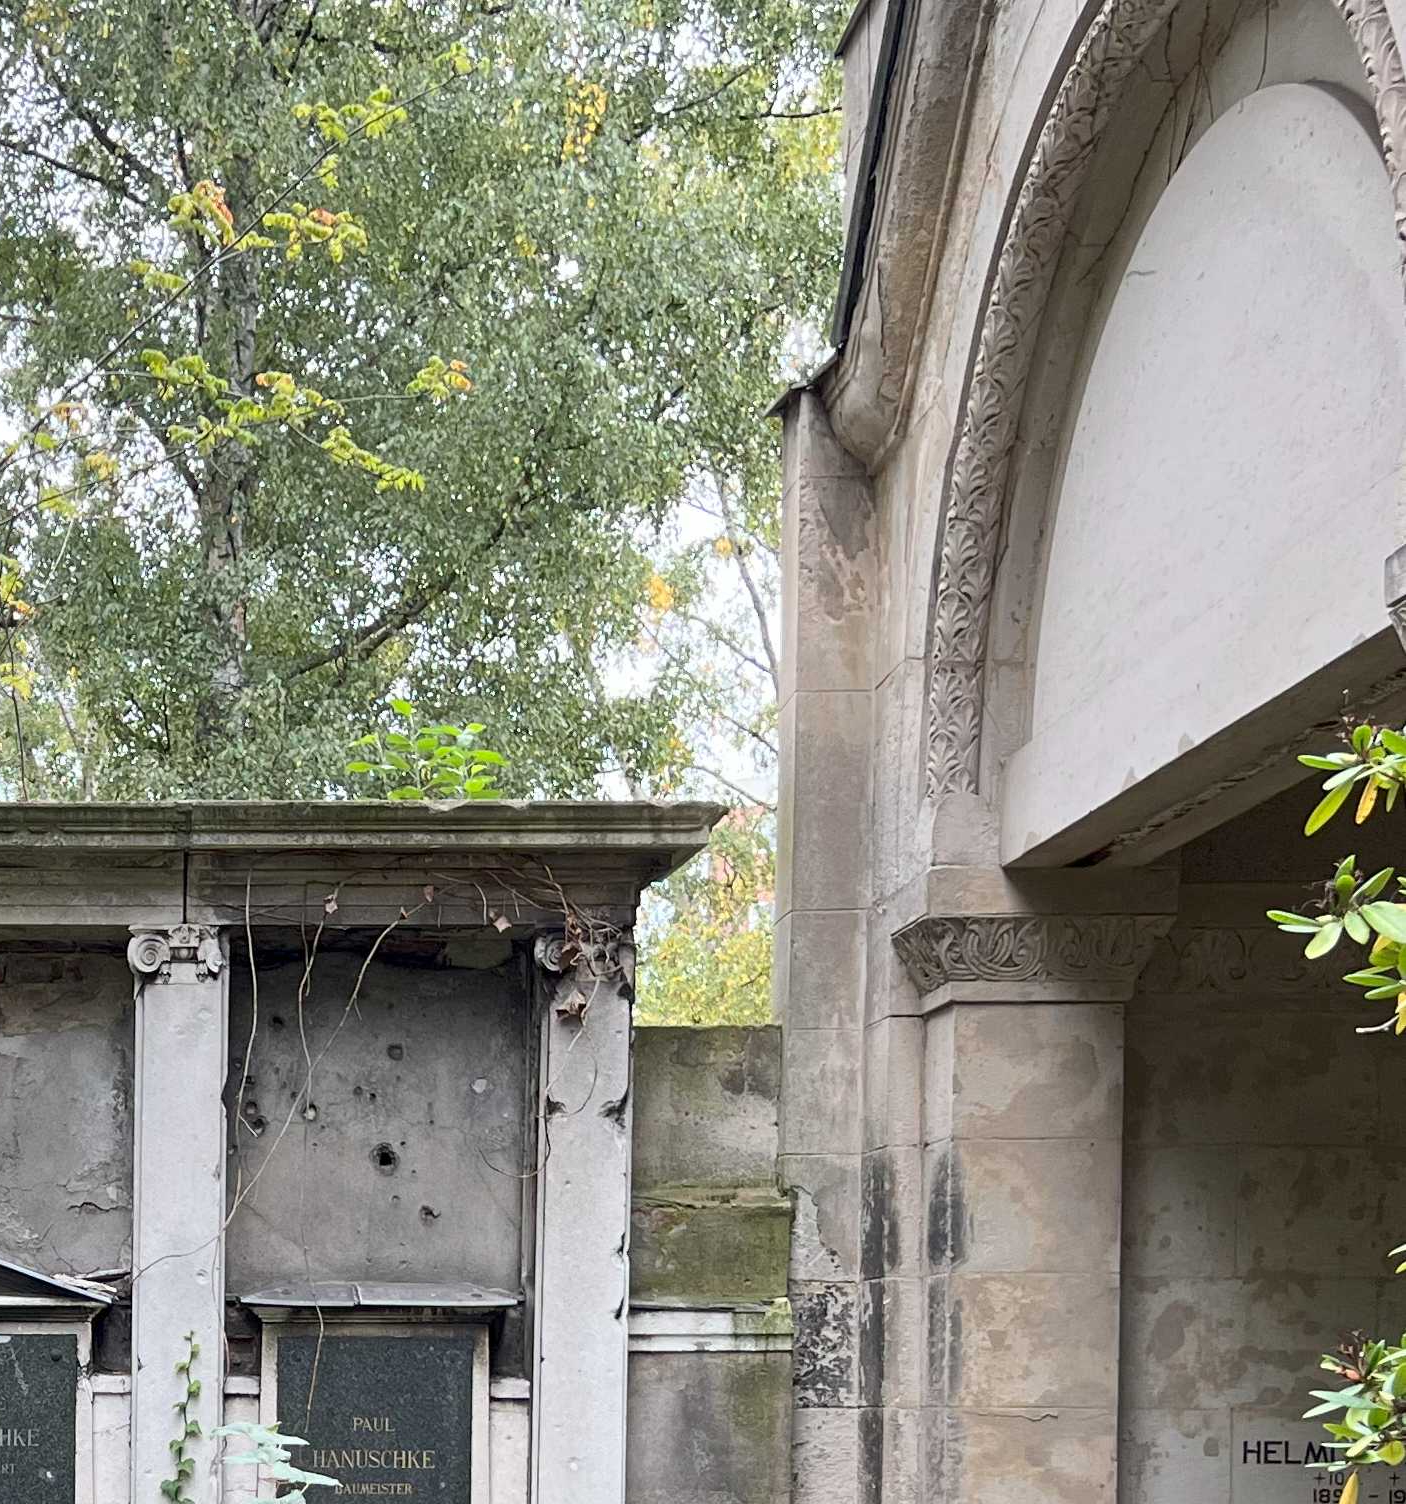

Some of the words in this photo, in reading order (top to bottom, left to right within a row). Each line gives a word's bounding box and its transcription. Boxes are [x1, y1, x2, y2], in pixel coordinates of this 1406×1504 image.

[352, 1416, 396, 1432] PAUL
[312, 1449, 436, 1469] HANUSCHKE
[334, 1483, 413, 1496] BAUMEISTER
